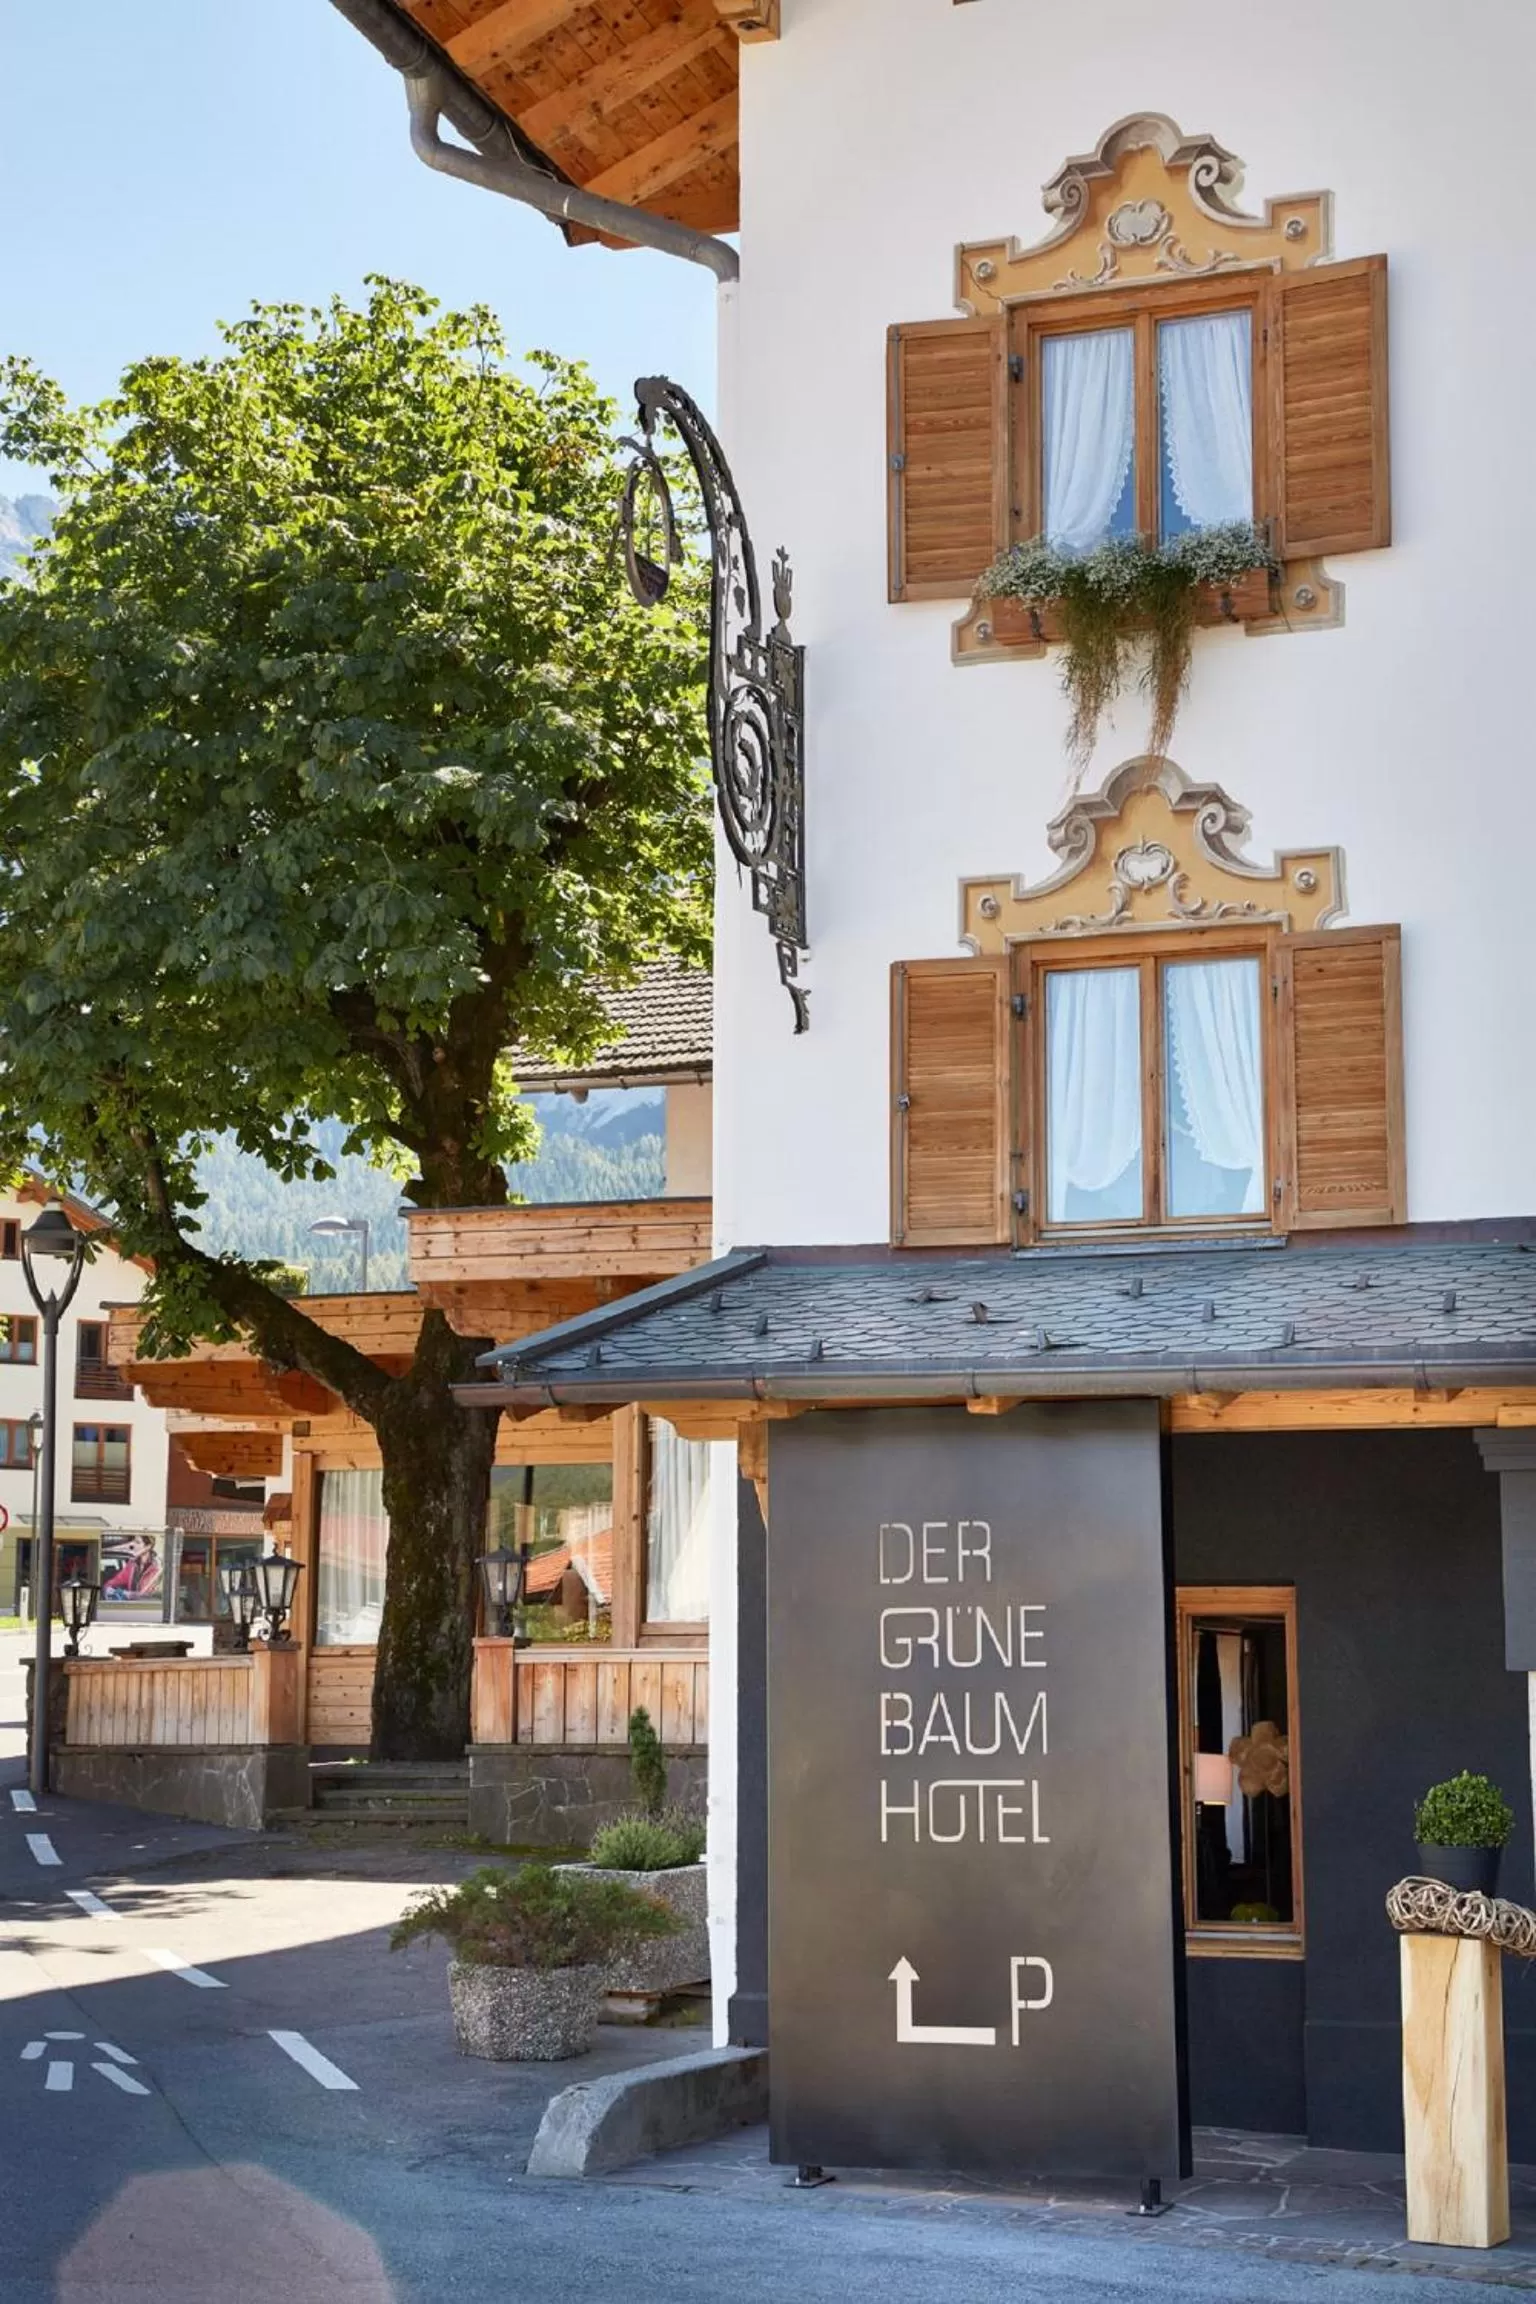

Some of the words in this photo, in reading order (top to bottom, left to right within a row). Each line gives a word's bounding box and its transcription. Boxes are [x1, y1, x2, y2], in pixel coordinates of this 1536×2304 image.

[879, 1521, 992, 1585] DER
[879, 1605, 1048, 1669] GRÜNE
[879, 1691, 1049, 1755] BAUM
[880, 1780, 1051, 1843] HOTEL
[1010, 1956, 1054, 2047] P
